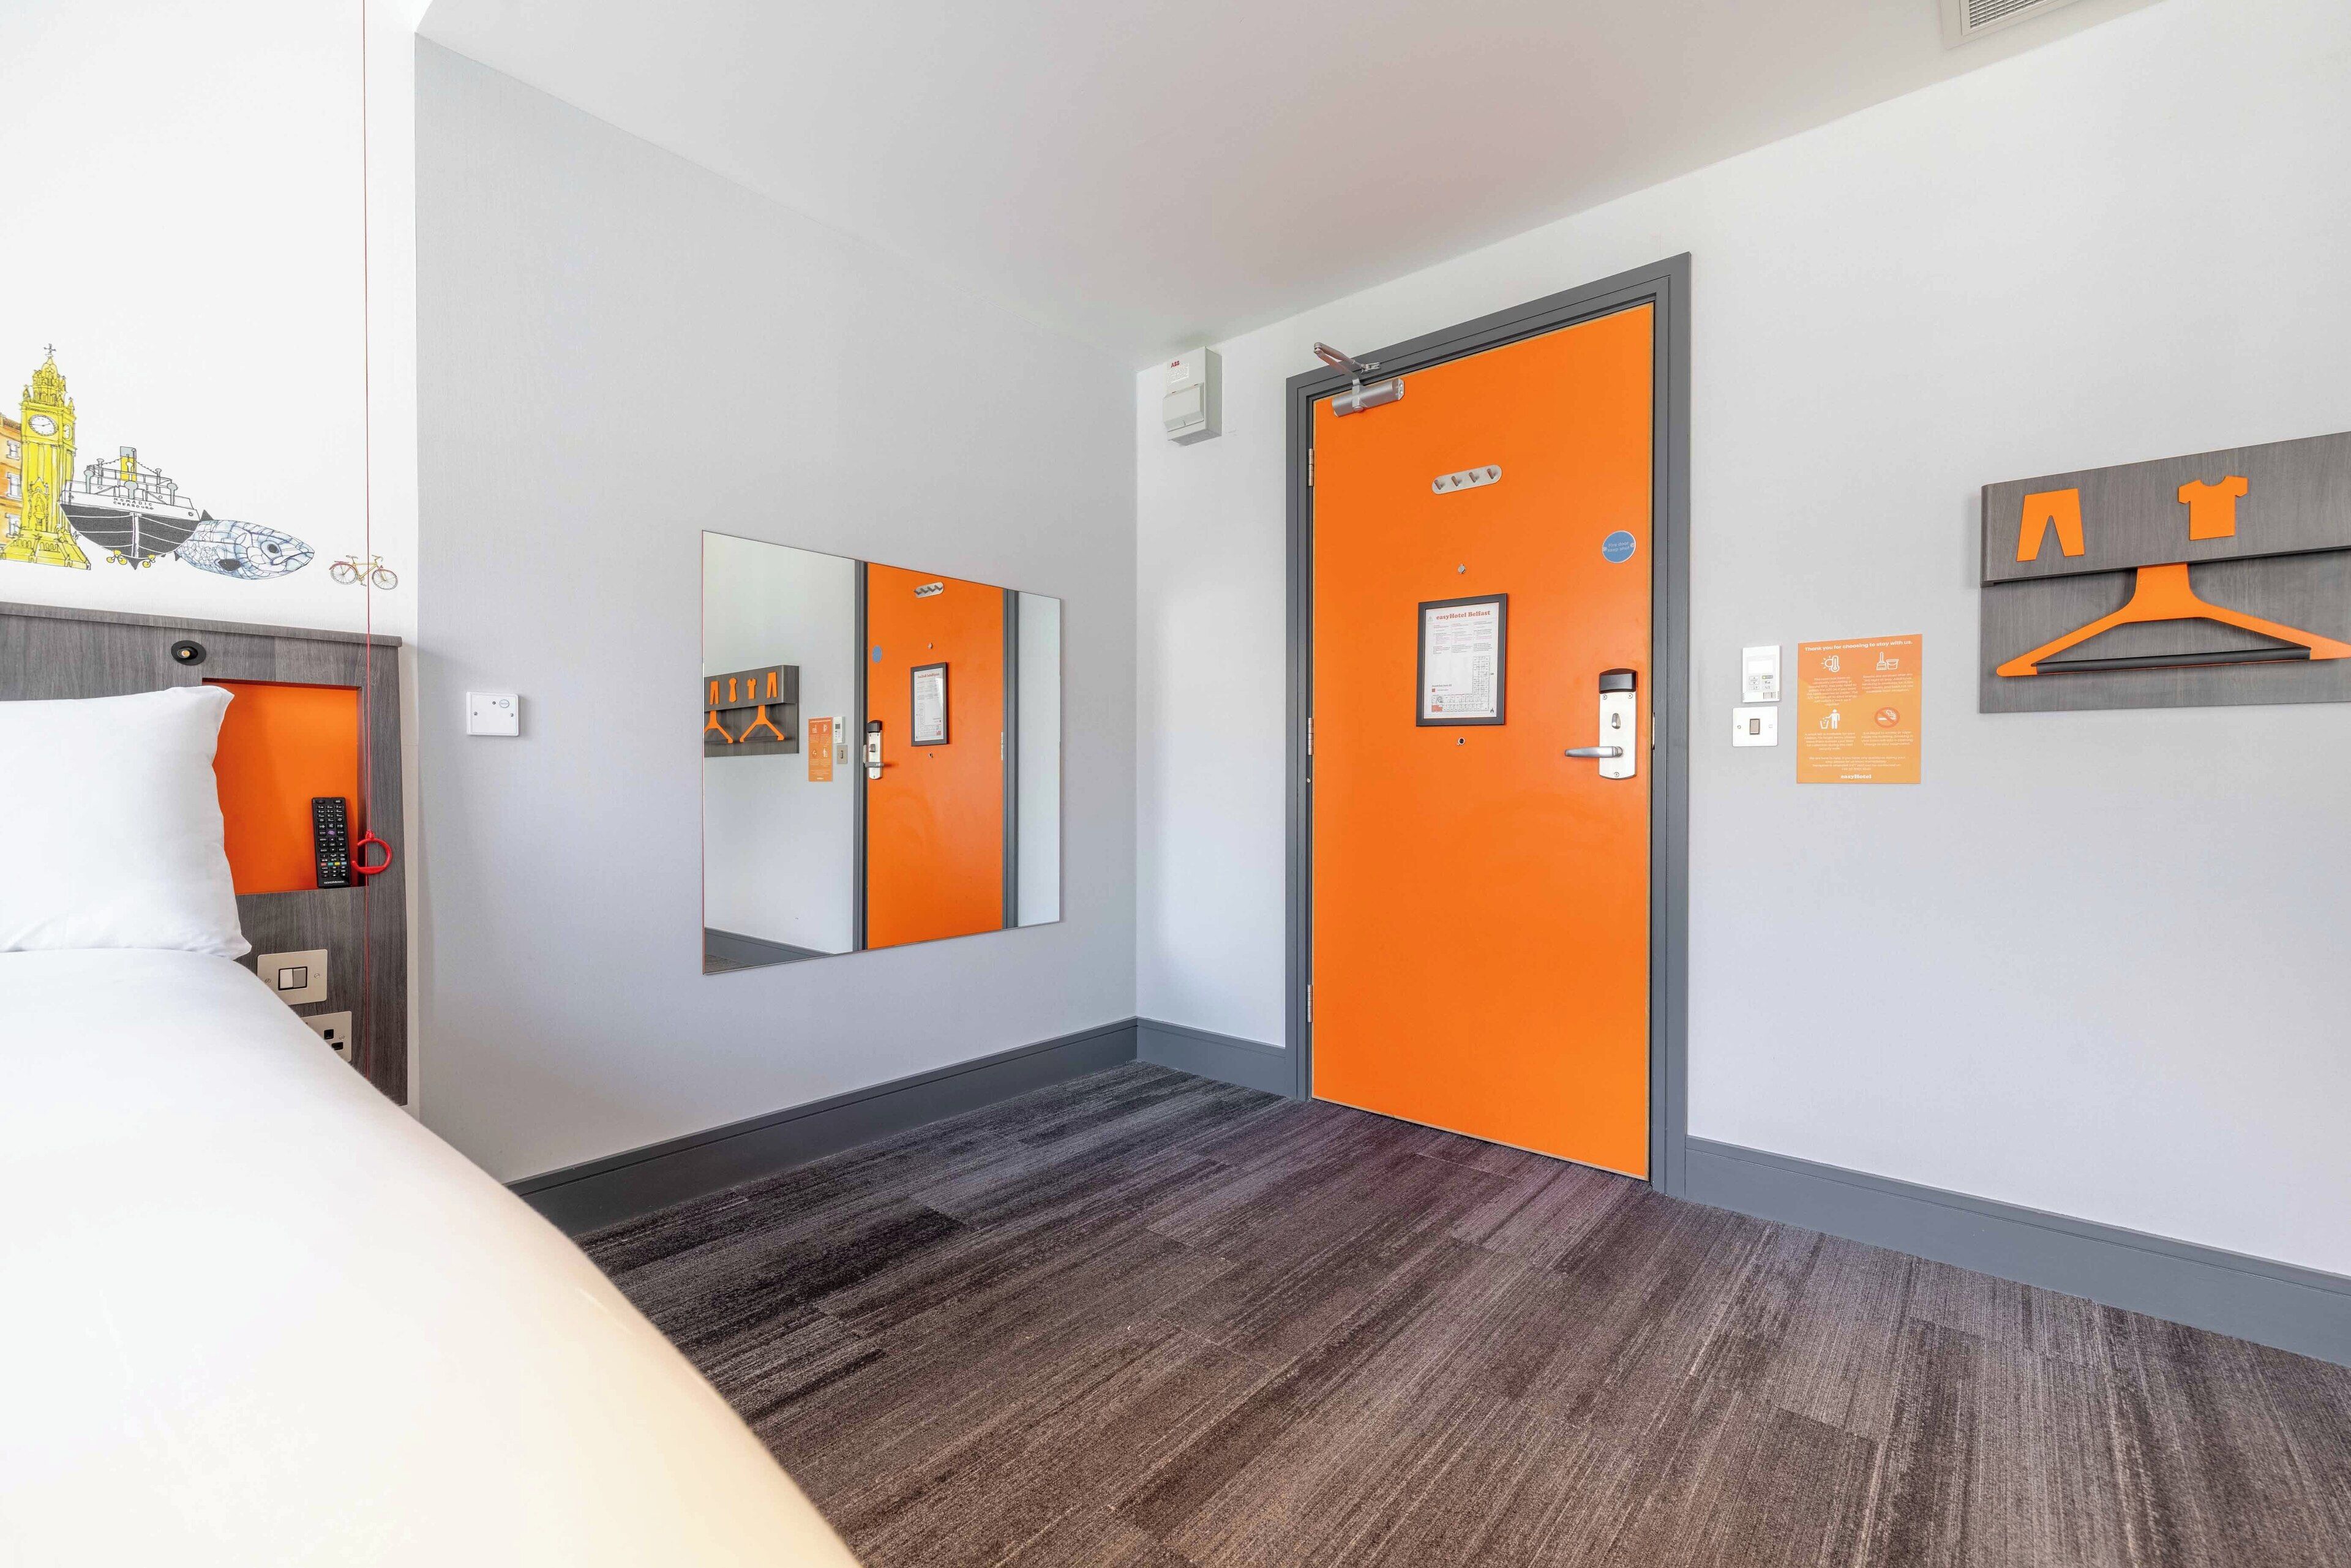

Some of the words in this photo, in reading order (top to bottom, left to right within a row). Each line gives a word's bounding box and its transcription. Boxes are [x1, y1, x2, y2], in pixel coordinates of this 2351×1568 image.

[113, 498, 152, 506] NOMADIC
[113, 501, 154, 510] CHERBOURG
[1436, 612, 1466, 620] easyHotel
